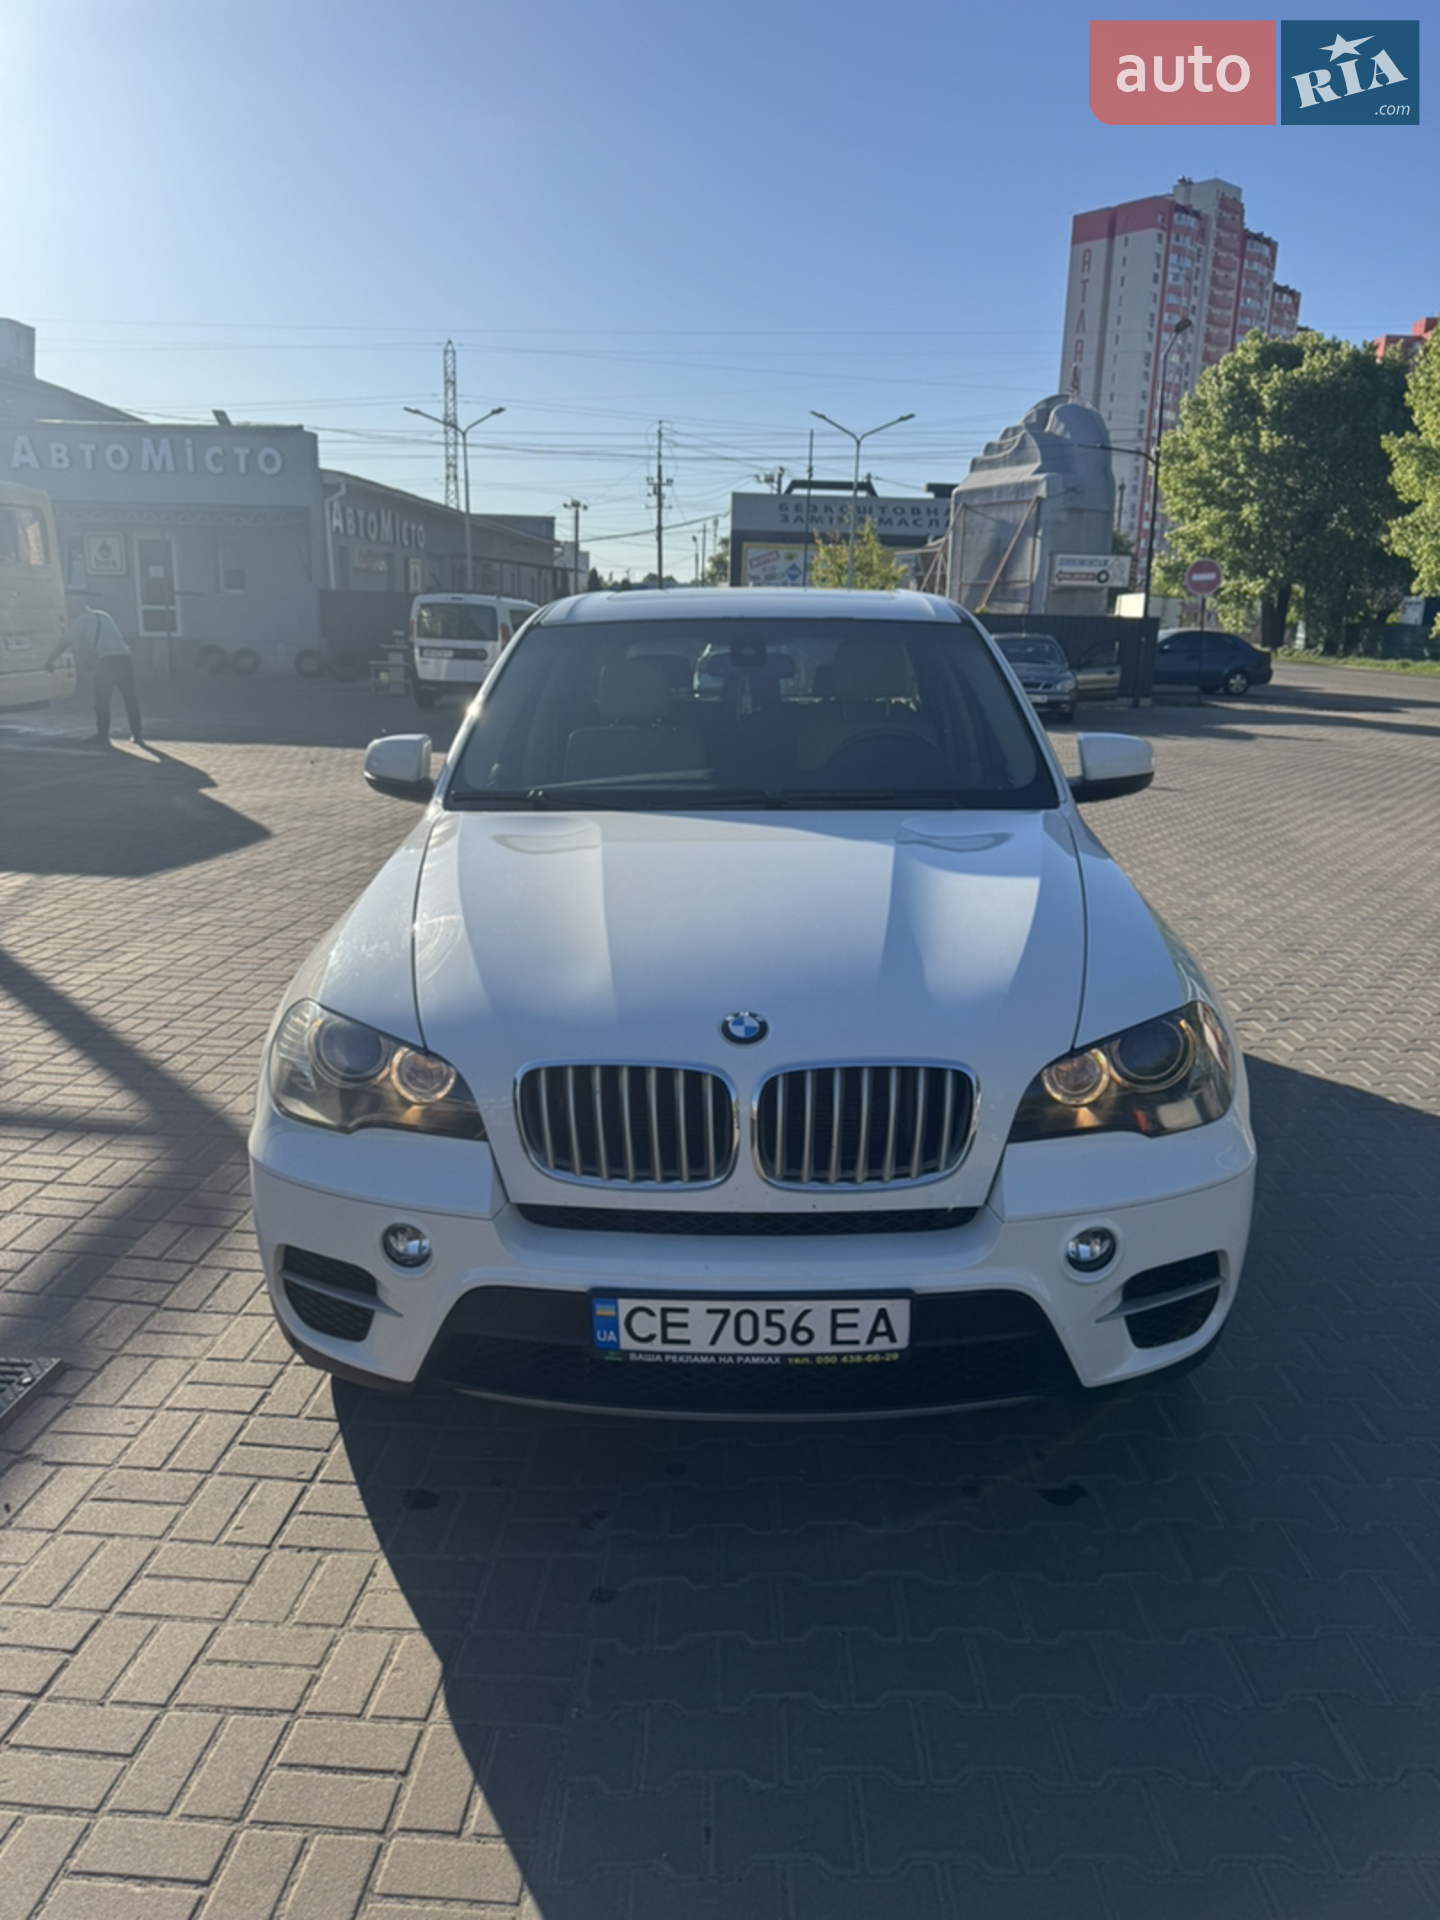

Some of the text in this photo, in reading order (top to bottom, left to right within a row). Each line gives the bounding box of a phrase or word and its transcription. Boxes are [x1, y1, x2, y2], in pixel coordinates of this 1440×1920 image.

[624, 1305, 898, 1347] CE 7056 EA
[596, 1330, 617, 1342] UA
[629, 1352, 663, 1363] ВАША
[664, 1354, 717, 1364] РЕКЛАМА
[718, 1355, 735, 1364] НА
[736, 1355, 782, 1365] РАМКАХ
